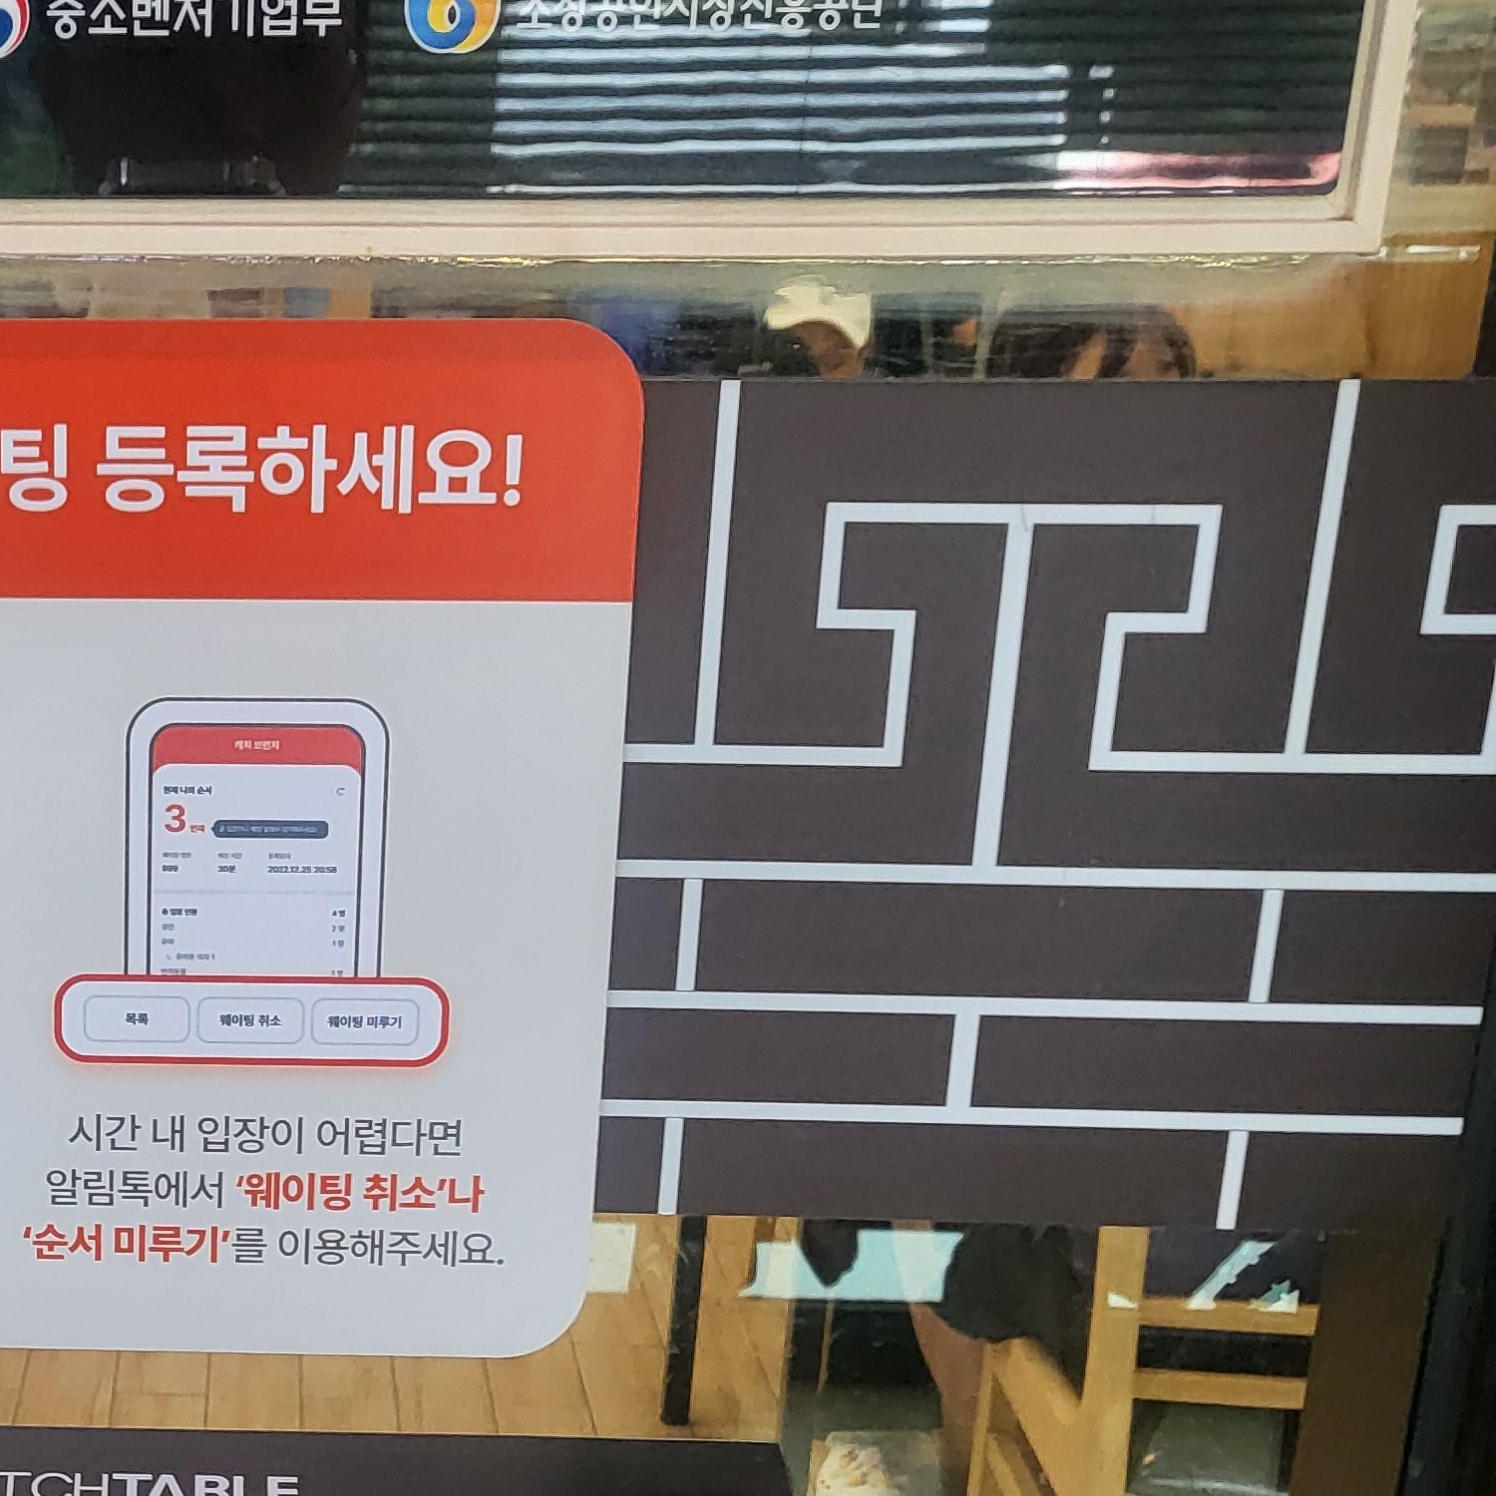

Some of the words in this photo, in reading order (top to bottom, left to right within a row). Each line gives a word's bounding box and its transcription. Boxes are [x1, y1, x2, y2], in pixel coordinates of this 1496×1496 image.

[96, 423, 523, 514] 등록하세요!
[164, 803, 186, 833] 3
[125, 1012, 149, 1026] 목록
[219, 1013, 255, 1028] 웨이팅
[258, 1013, 282, 1028] 취소
[327, 1015, 364, 1029] 웨이팅
[366, 1015, 402, 1030] 미루기
[69, 1114, 141, 1152] 시간
[152, 1115, 185, 1152] 내
[197, 1116, 304, 1155] 입장이
[316, 1118, 462, 1157] 어렵다면
[46, 1168, 224, 1208] 알림톡에서
[278, 1228, 505, 1267] 이용해주세요.
